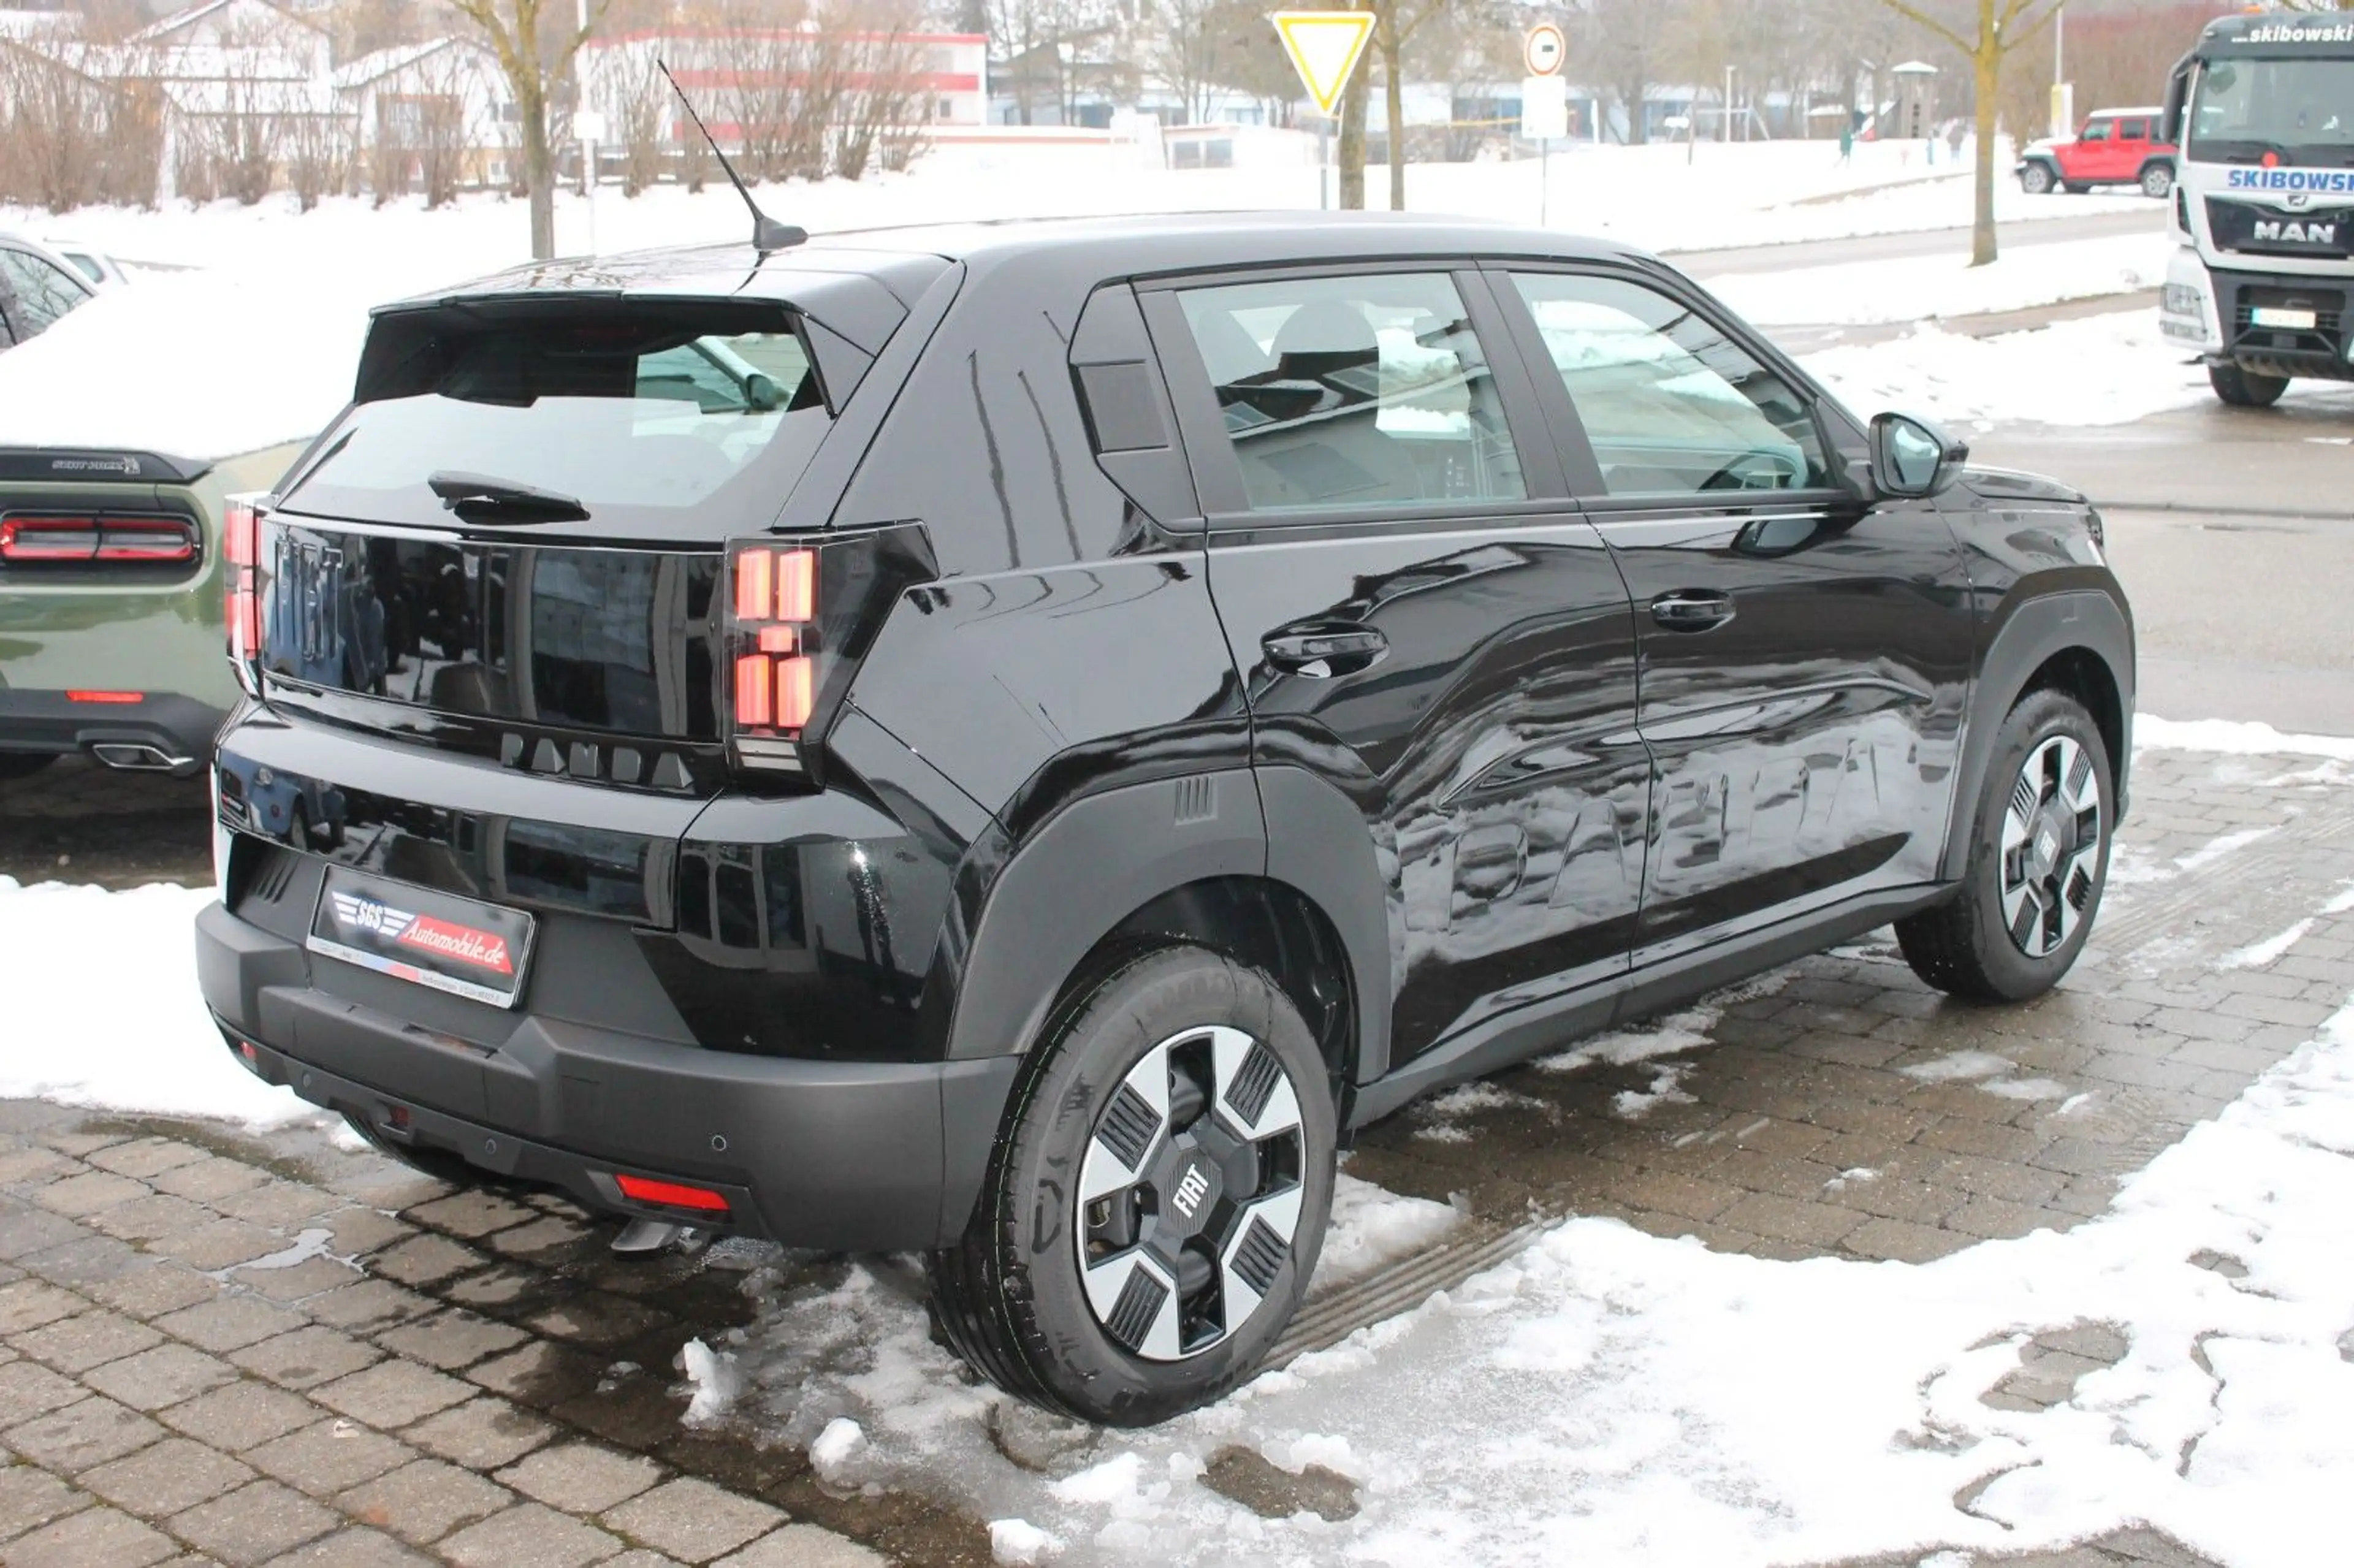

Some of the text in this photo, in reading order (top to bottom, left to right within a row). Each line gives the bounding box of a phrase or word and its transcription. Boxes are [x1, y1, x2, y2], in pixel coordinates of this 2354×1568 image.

[2253, 220, 2335, 243] MAN
[500, 732, 695, 789] PANDA
[357, 900, 383, 930] SGS
[402, 919, 505, 965] Automobile.de
[1172, 1163, 1209, 1219] FIAT
